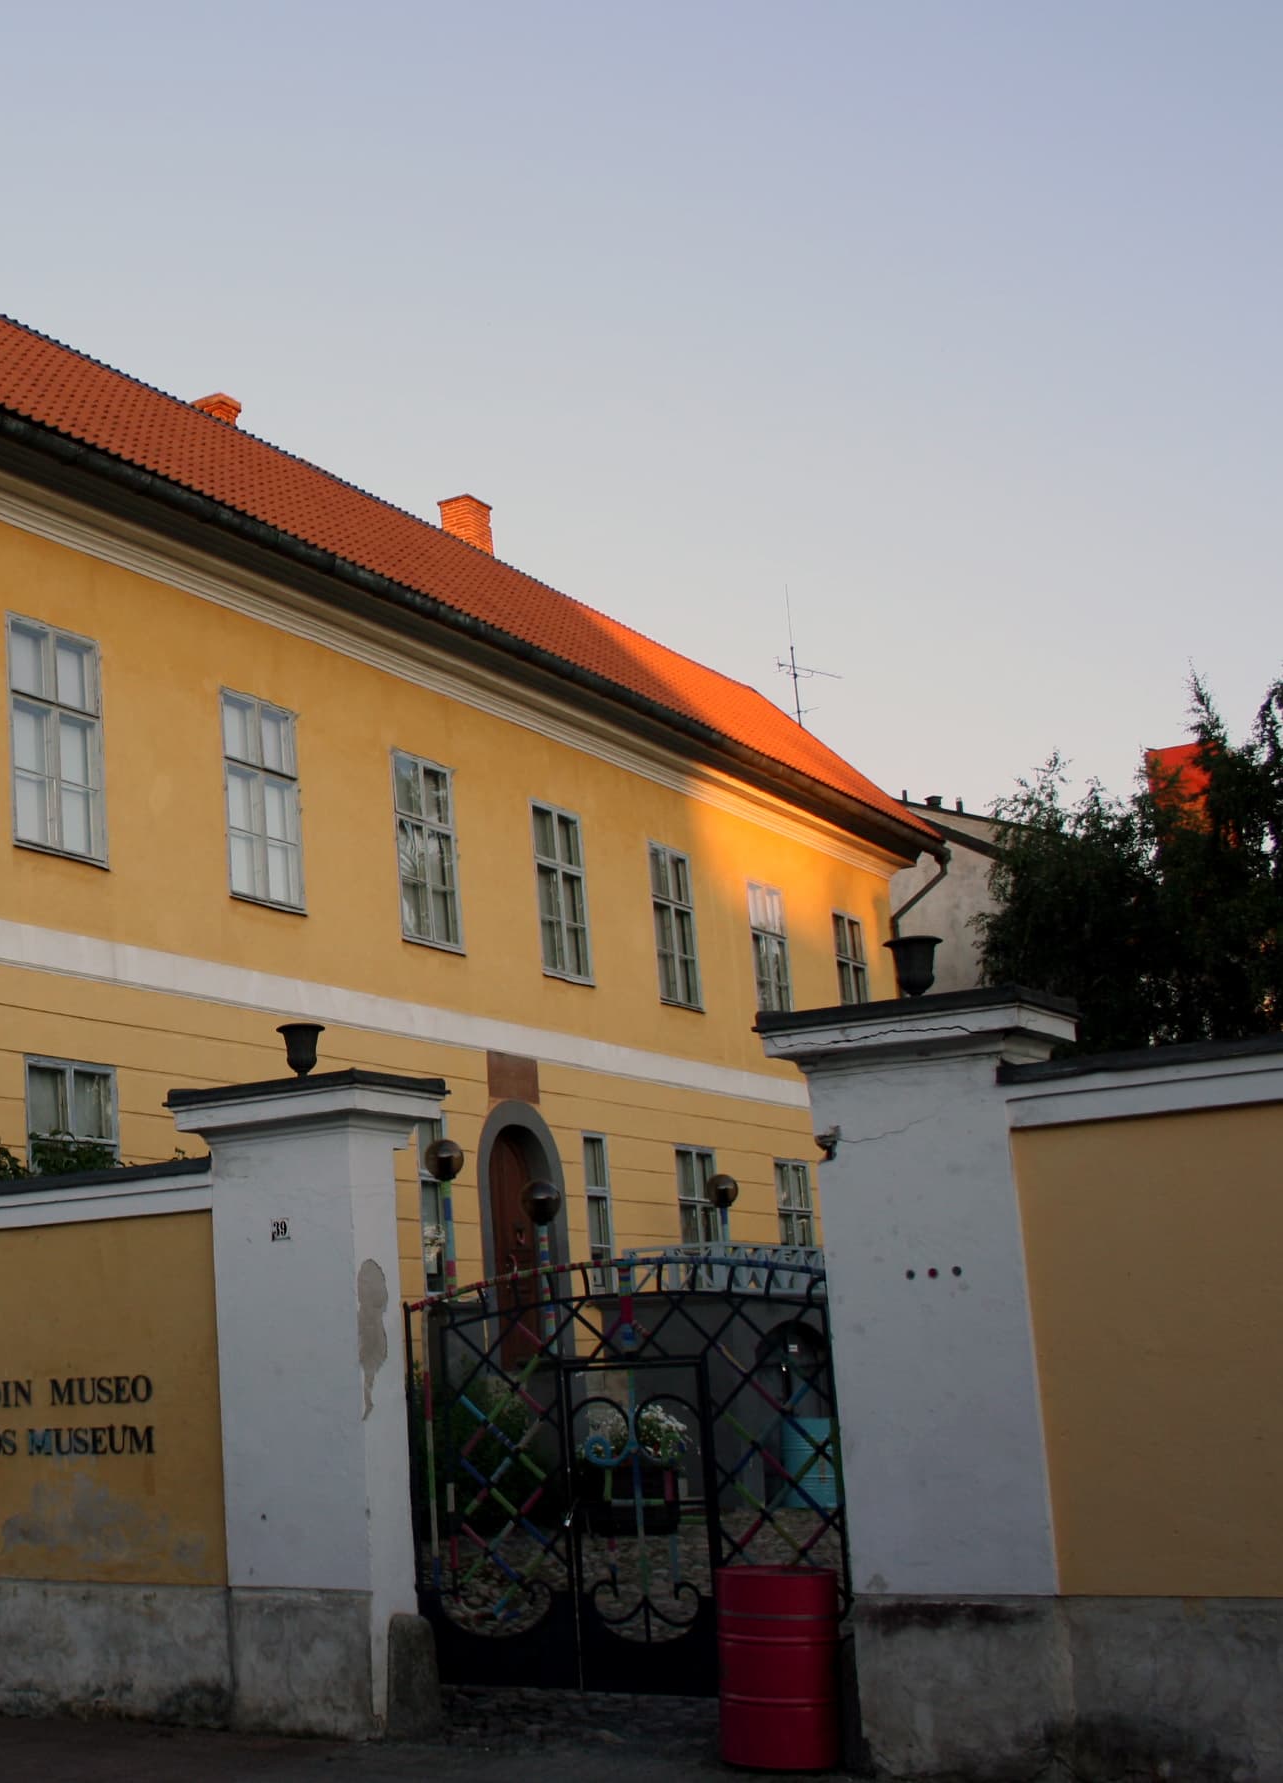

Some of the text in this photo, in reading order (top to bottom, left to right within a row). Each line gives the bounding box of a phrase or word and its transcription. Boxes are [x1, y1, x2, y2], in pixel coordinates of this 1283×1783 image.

[273, 1220, 287, 1236] 39
[49, 1375, 153, 1407] MUSEO
[28, 1424, 155, 1457] MUSEUM
